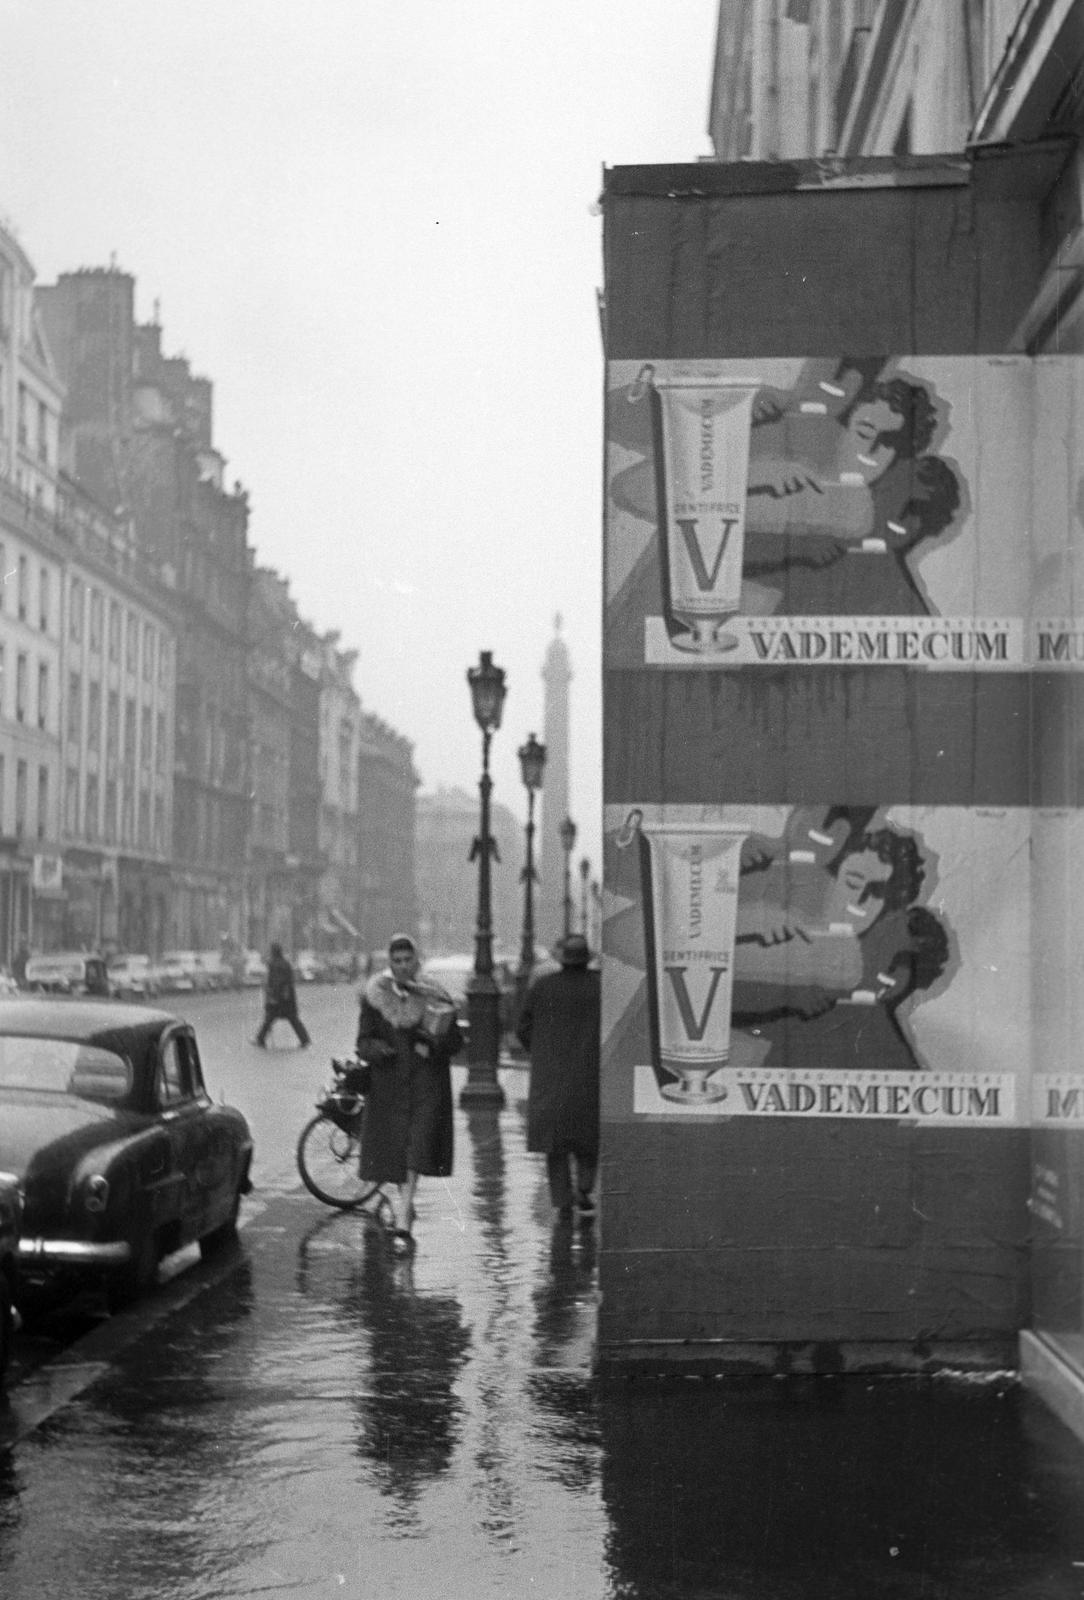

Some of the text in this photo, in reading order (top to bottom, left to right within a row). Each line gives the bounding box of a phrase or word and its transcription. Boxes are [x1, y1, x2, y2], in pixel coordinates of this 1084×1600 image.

[676, 519, 739, 591] V
[748, 631, 1008, 660] VADEMECUM
[664, 966, 728, 1041] V
[737, 1082, 1001, 1117] VADEMECUM
